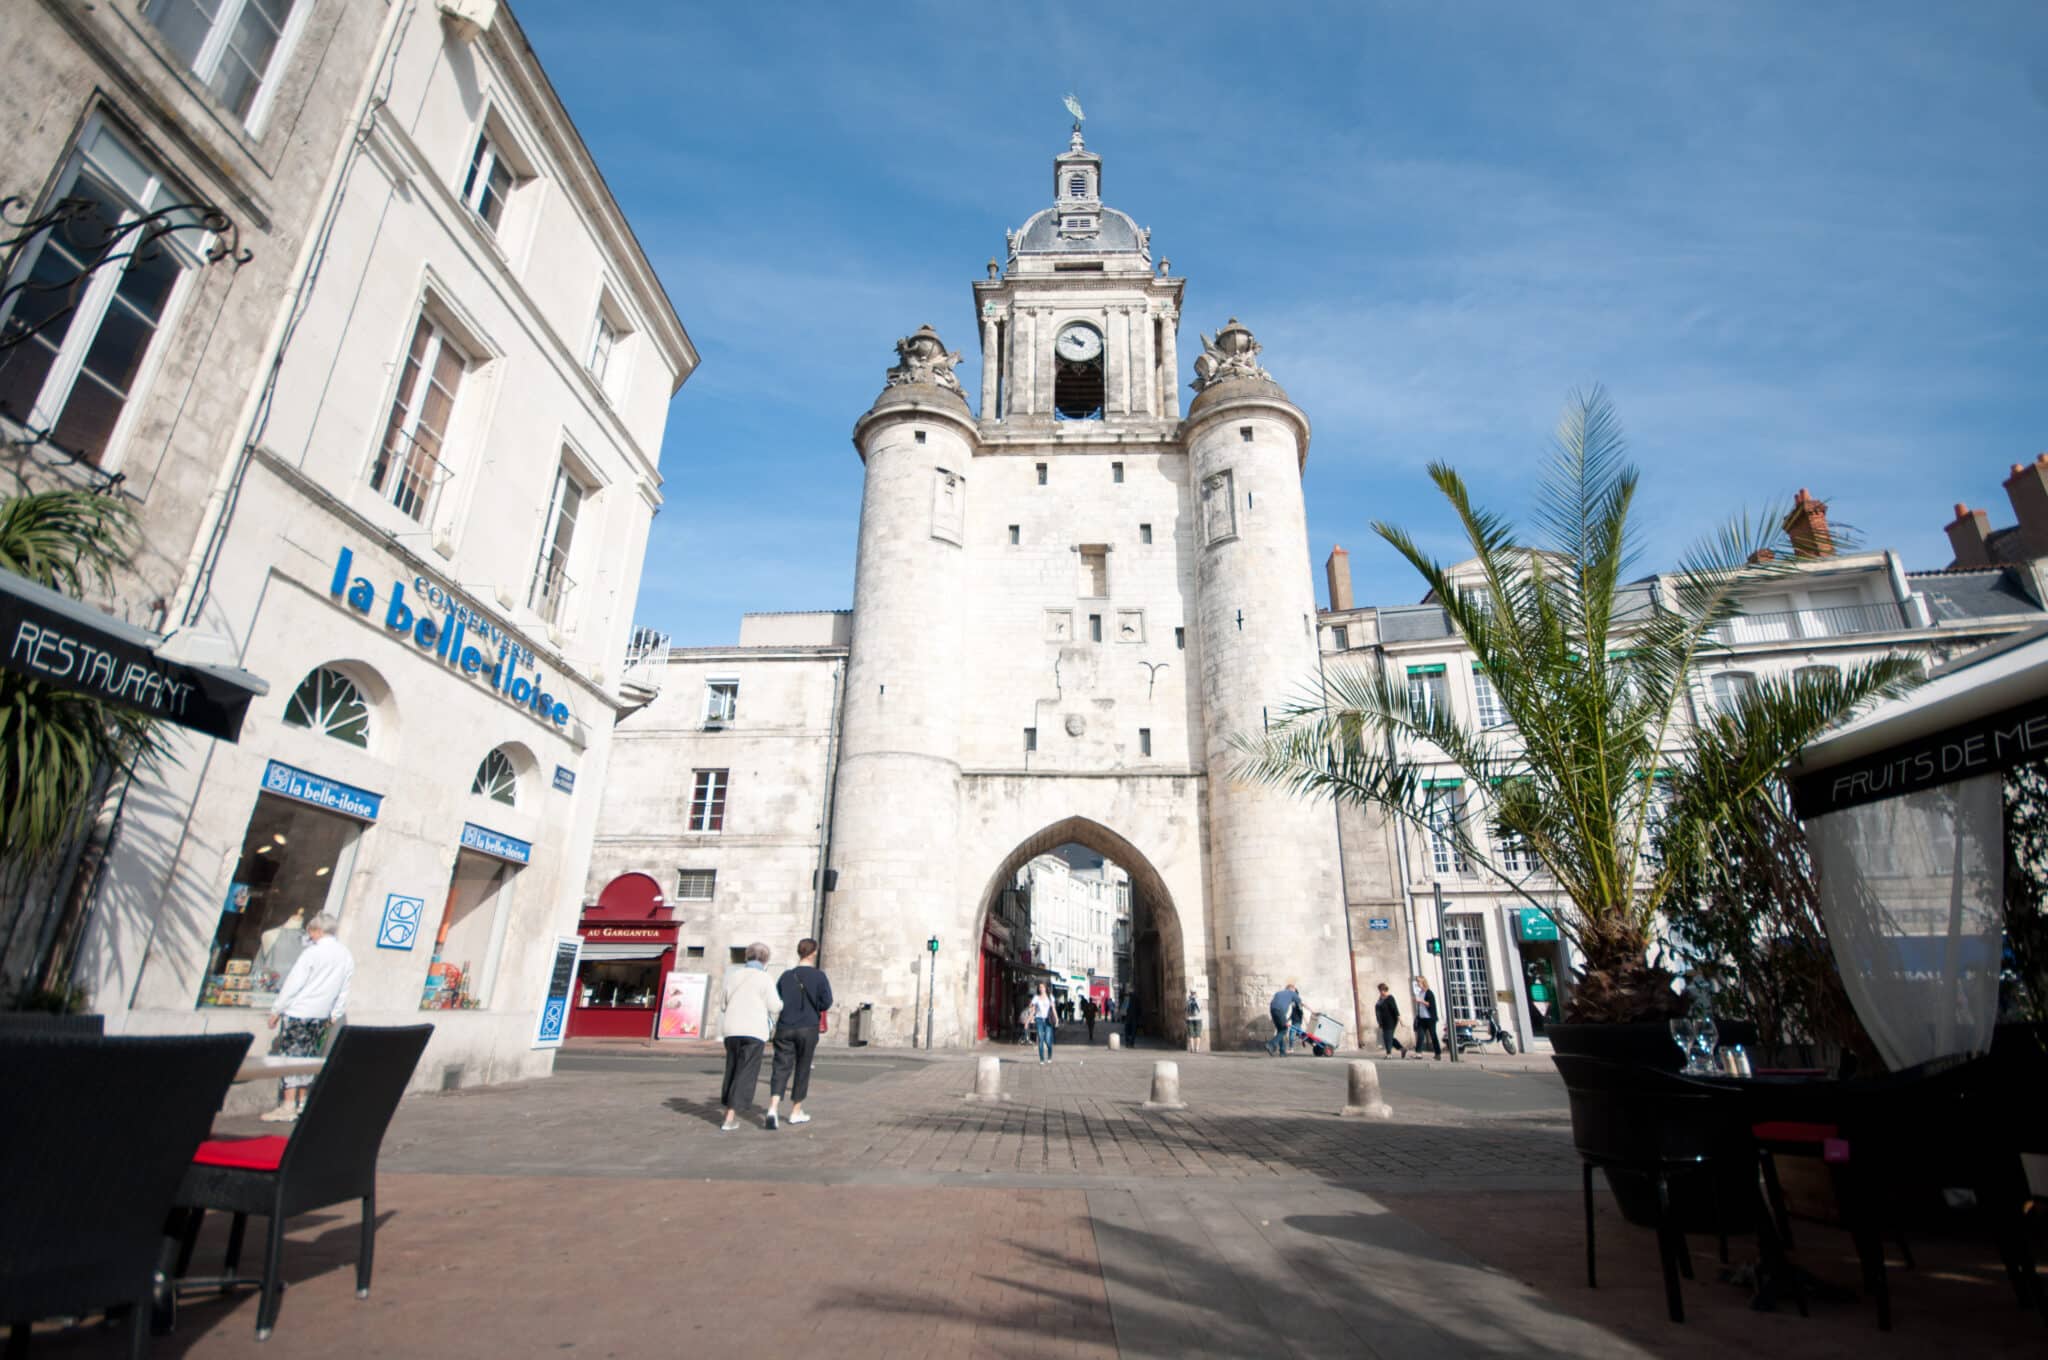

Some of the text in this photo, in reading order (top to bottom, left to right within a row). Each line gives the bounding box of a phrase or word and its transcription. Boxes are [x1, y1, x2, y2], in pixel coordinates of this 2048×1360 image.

[11, 620, 195, 715] RESTAURANT
[331, 546, 569, 726] la belle-iloise
[289, 777, 302, 796] la
[304, 782, 372, 817] belle-iloise
[1832, 752, 1934, 801] FRUITS
[1941, 734, 1987, 773] DE
[587, 929, 601, 937] AU
